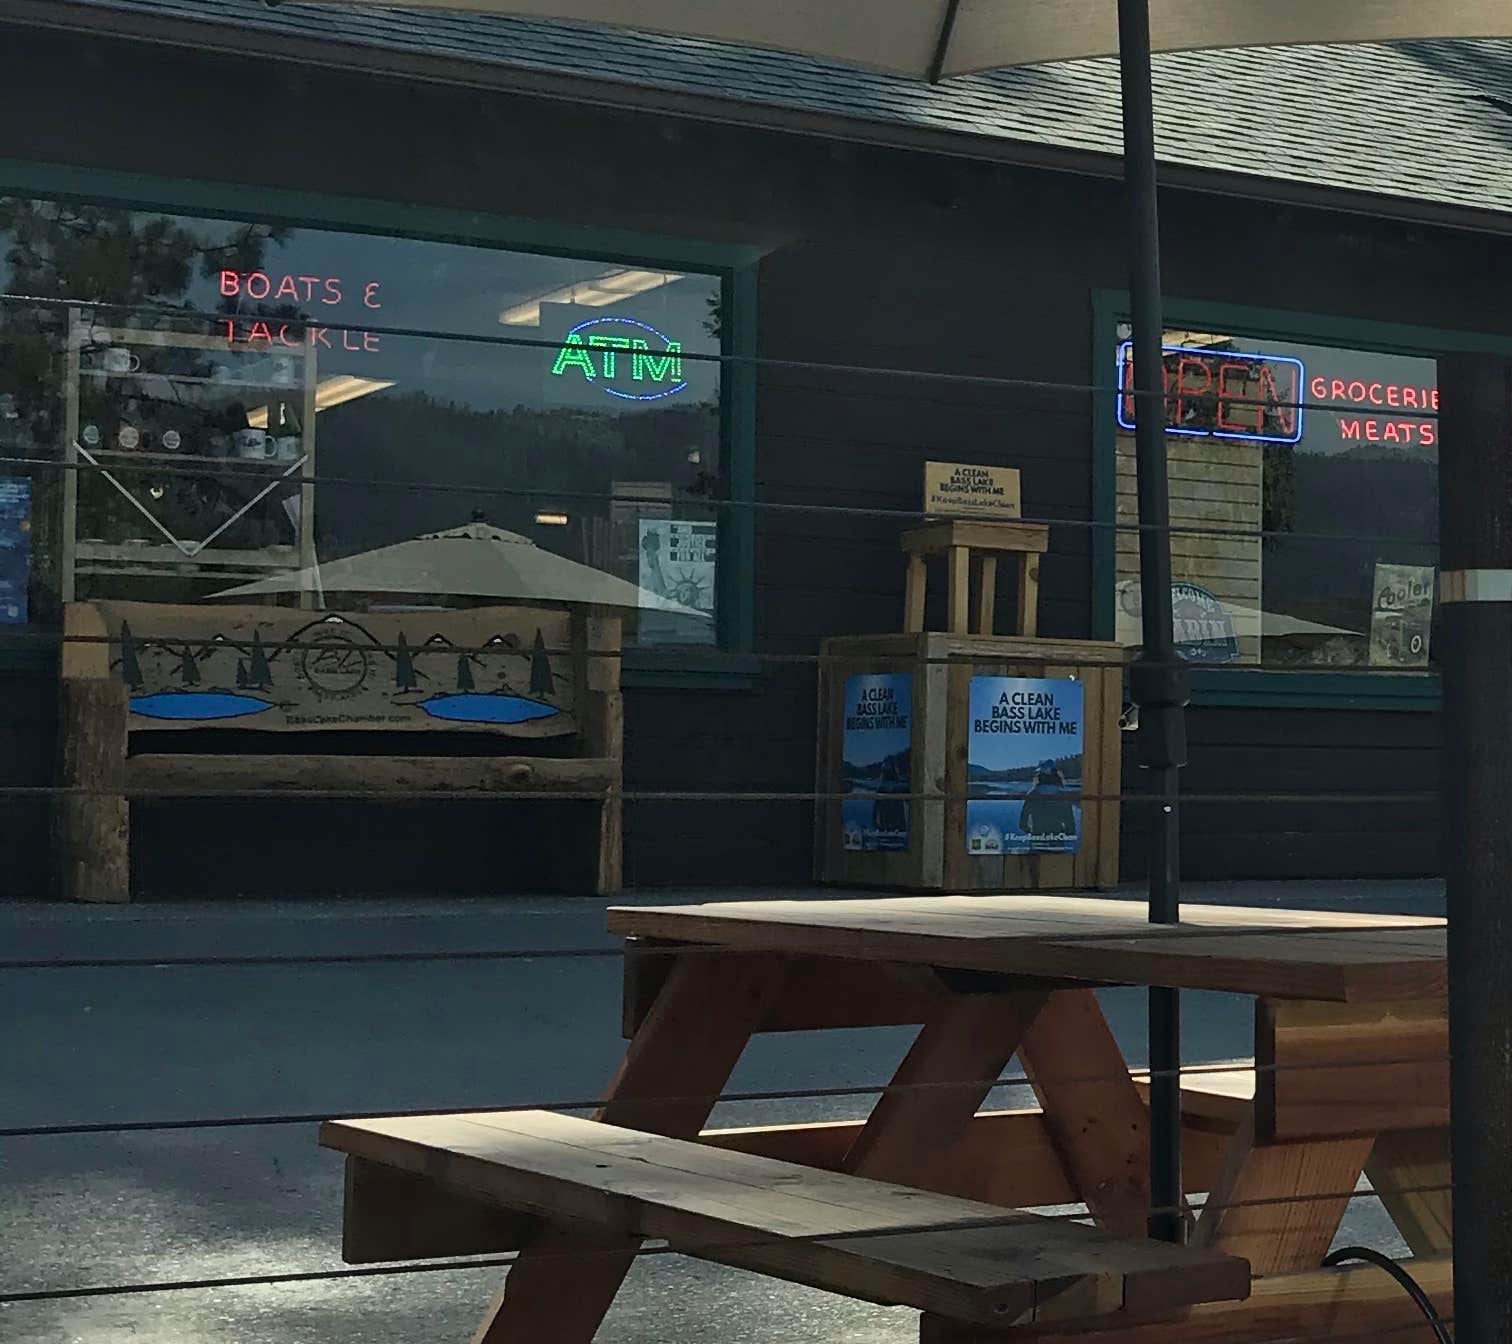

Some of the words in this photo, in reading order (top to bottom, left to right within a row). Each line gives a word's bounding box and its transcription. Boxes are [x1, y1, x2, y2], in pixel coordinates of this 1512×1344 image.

[220, 270, 342, 305] BOATS
[218, 318, 380, 352] TACKLE
[552, 334, 682, 382] ATM
[1340, 419, 1435, 445] MEATS
[950, 476, 971, 485] BASS
[973, 477, 994, 486] LAKE
[962, 469, 989, 478] CLEAN
[940, 483, 969, 494] BEGINS
[971, 486, 991, 495] WITH
[869, 688, 895, 702] CLEAN
[999, 692, 1009, 705] A
[1012, 692, 1054, 706] CLEAN
[992, 706, 1025, 720] BASS
[1028, 707, 1061, 721] LAKE
[974, 719, 1021, 734] BEGINS
[1023, 721, 1056, 734] WITH
[1059, 722, 1077, 735] ME
